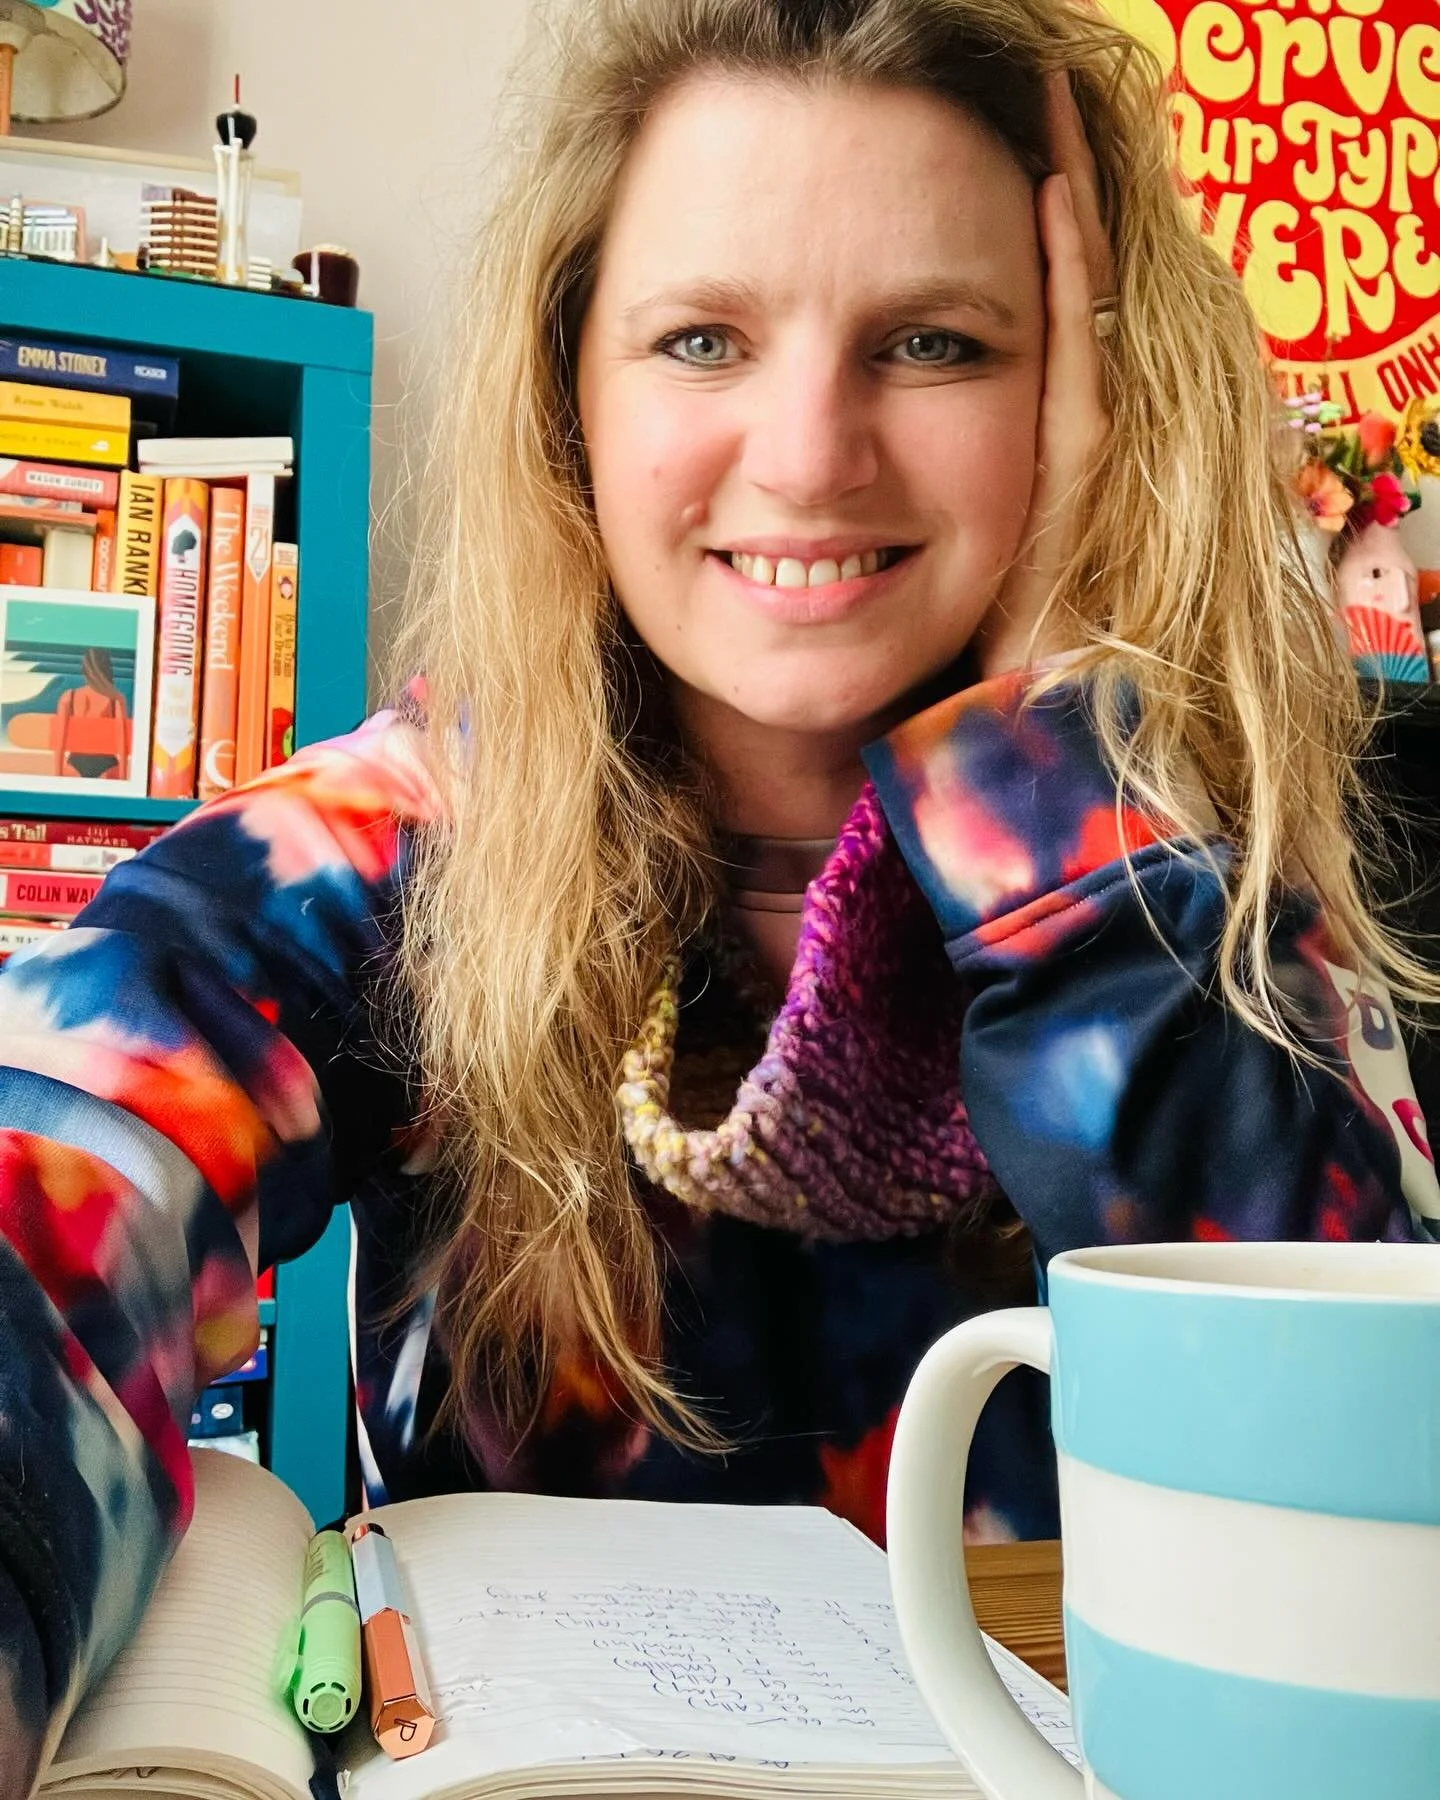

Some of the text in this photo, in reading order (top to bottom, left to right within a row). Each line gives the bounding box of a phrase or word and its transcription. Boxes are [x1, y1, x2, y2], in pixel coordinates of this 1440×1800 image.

[1167, 91, 1440, 213] ur Typ
[18, 346, 56, 371] EMMA
[129, 484, 155, 522] IAN
[209, 503, 242, 671] The Weekend
[163, 568, 198, 677] HOMEGOING
[10, 825, 46, 841] Tail
[67, 835, 129, 849] HAYWARD
[17, 884, 61, 903] COLIN
